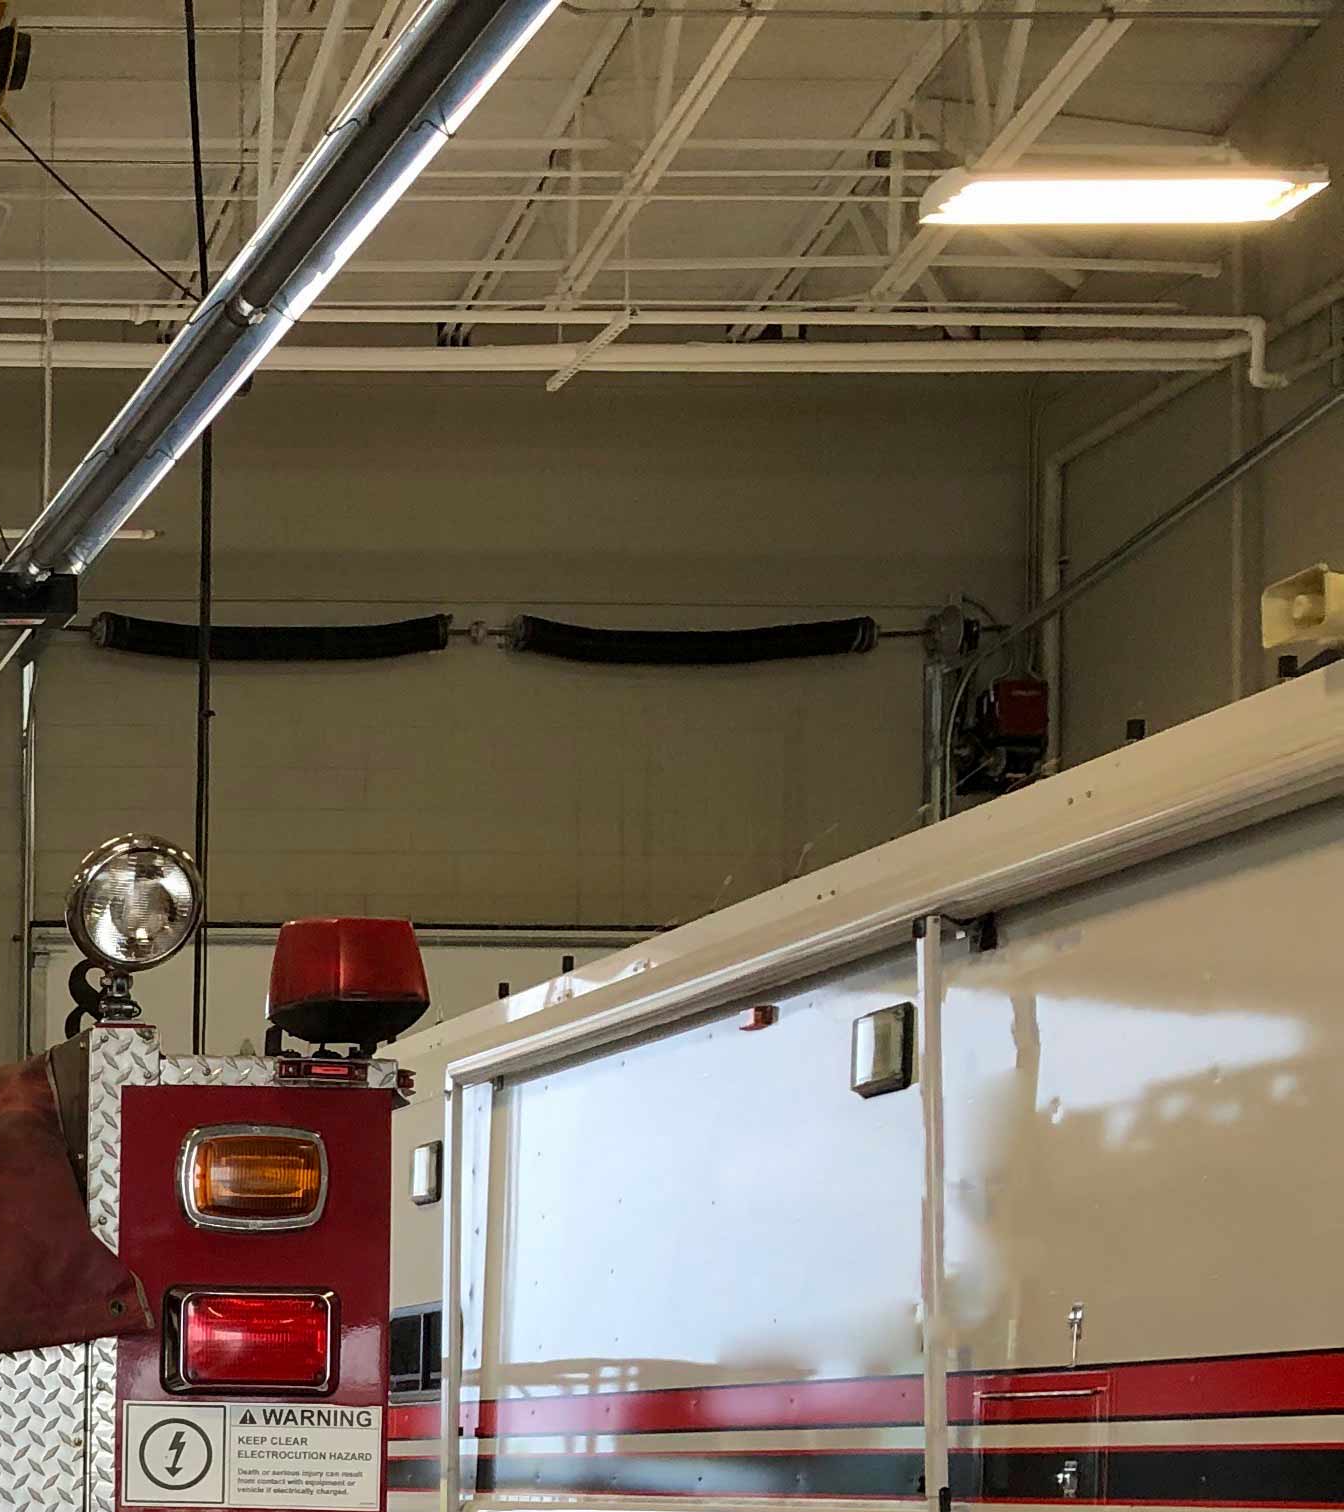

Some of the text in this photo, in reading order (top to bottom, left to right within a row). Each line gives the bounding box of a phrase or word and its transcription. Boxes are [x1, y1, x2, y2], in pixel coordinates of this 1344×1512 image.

[262, 1408, 372, 1427] WARNING
[238, 1436, 308, 1446] KEEP CLEAR
[237, 1450, 372, 1461] ELECTROCUTION HAZARD
[237, 1468, 260, 1476] Death
